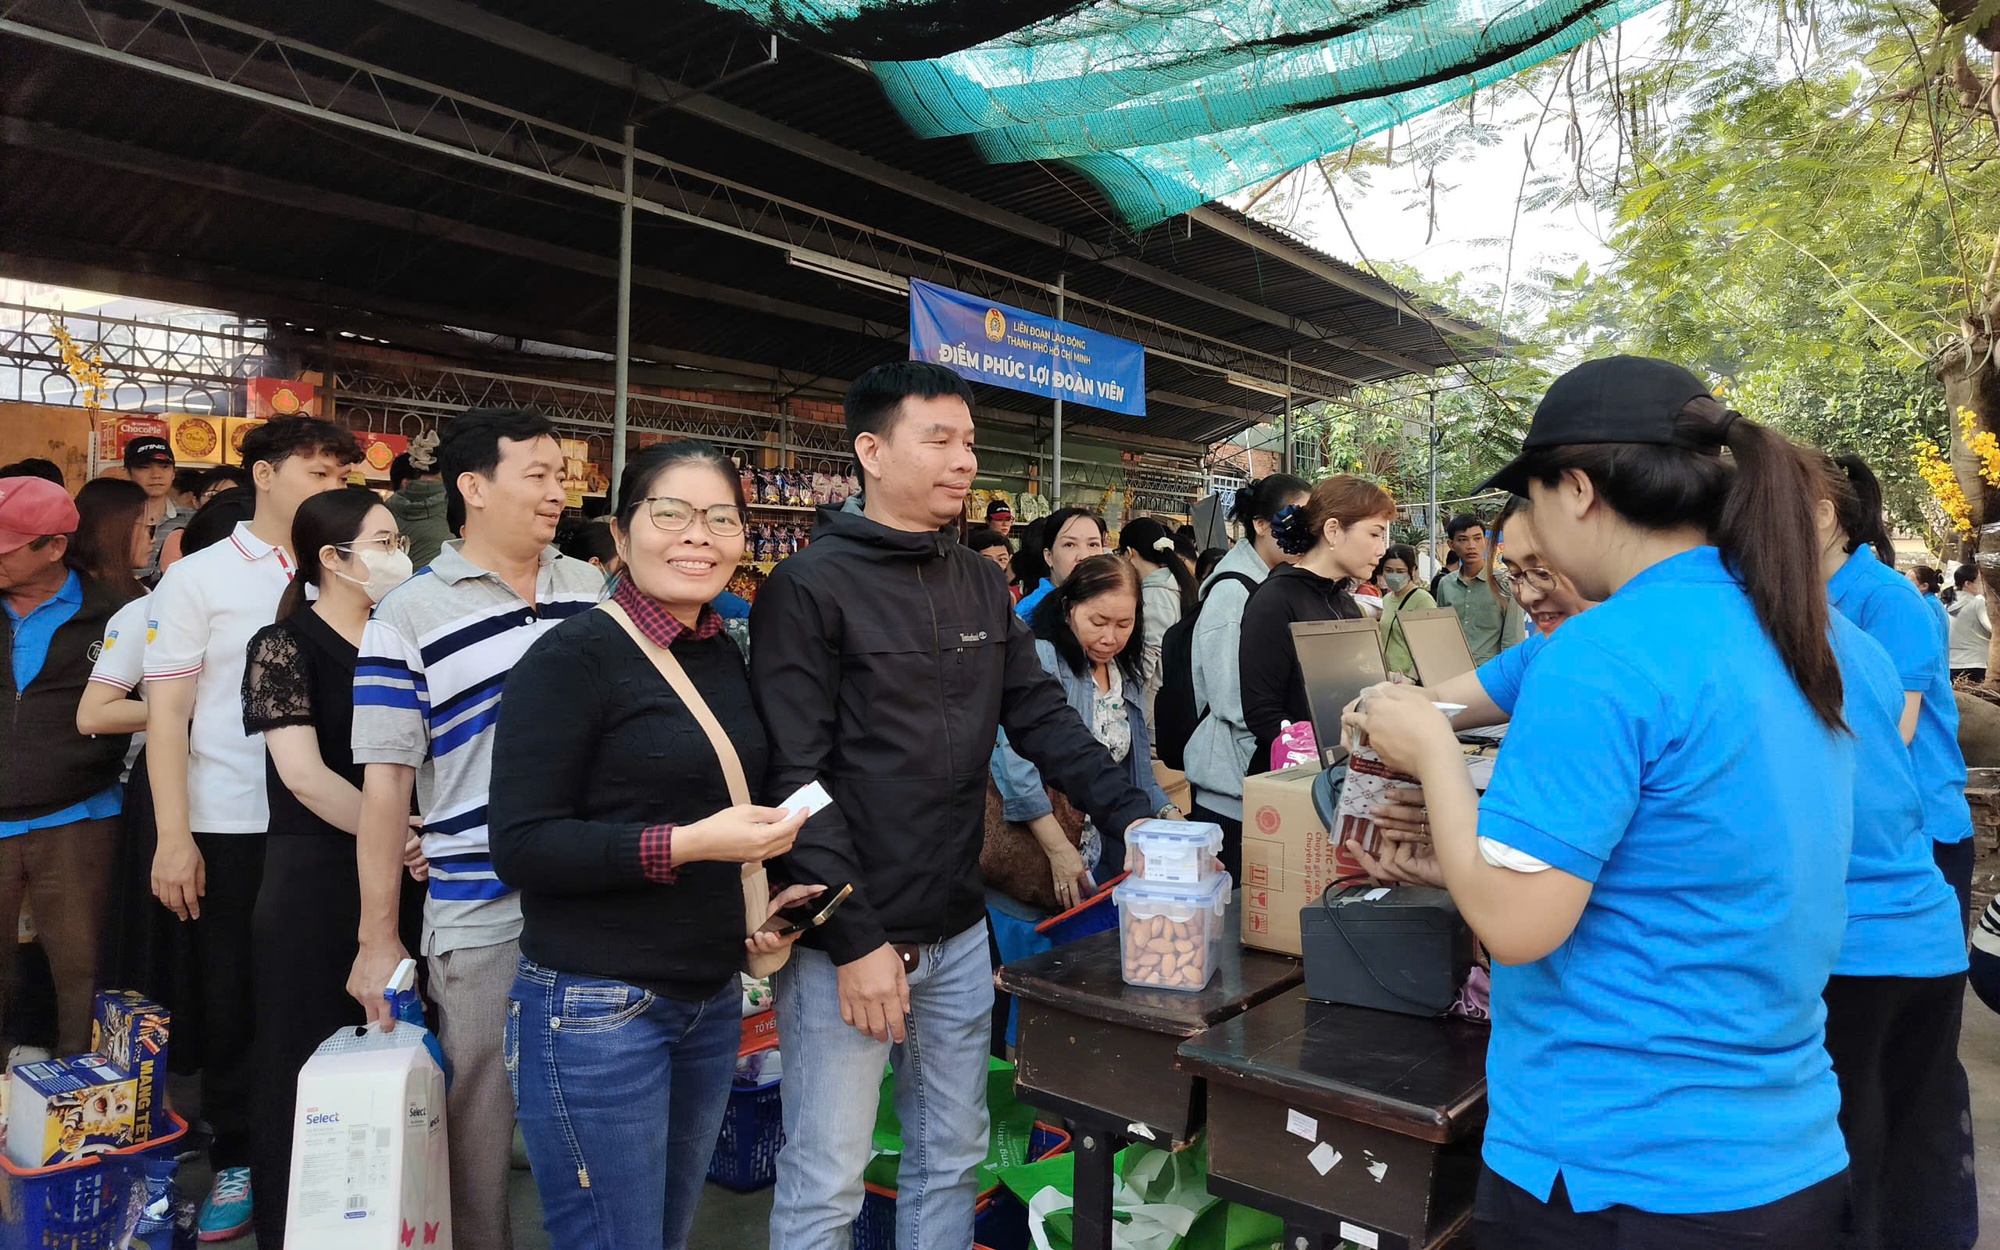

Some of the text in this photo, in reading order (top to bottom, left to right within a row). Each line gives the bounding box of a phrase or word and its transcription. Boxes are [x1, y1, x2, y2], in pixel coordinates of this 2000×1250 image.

[1013, 321, 1086, 350] LIÊN ĐOÀN LAO ĐỘNG
[1007, 335, 1091, 365] THÀNH PHỐ HỒ CHÍ MINH
[939, 341, 1125, 402] ĐIỂM PHÚC LỢI ĐOÀN VIÊN
[134, 1059, 155, 1144] MANG TẾT
[409, 1107, 426, 1117] Select
[306, 1111, 341, 1125] Select
[430, 1114, 440, 1127] ect
[997, 1120, 1006, 1147] xanh
